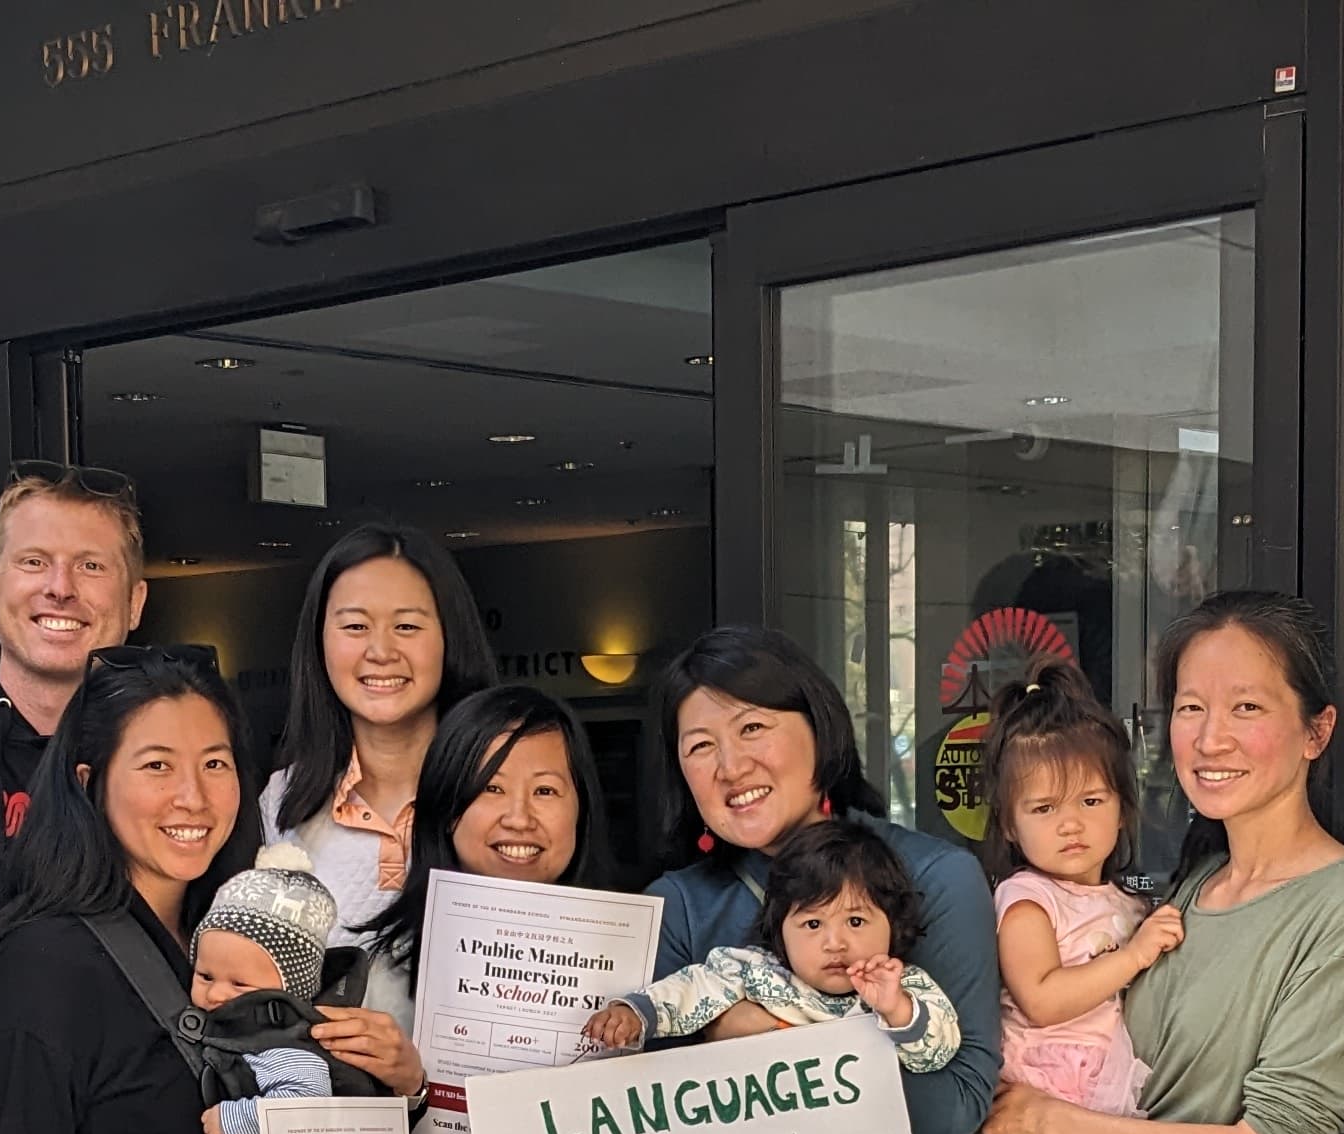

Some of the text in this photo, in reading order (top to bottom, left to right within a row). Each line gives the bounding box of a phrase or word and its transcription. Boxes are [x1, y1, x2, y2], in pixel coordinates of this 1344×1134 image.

[43, 0, 354, 88] 555 FRANK
[499, 651, 576, 677] TRICT
[940, 749, 982, 764] AUTO
[456, 938, 615, 972] A Public Mandarin
[484, 961, 579, 988] Immersion
[493, 983, 550, 1005] School
[551, 990, 579, 1009] for
[581, 995, 605, 1011] SF
[453, 1023, 468, 1036] 66
[506, 1033, 540, 1046] 400+
[433, 1118, 469, 1132] Scan the
